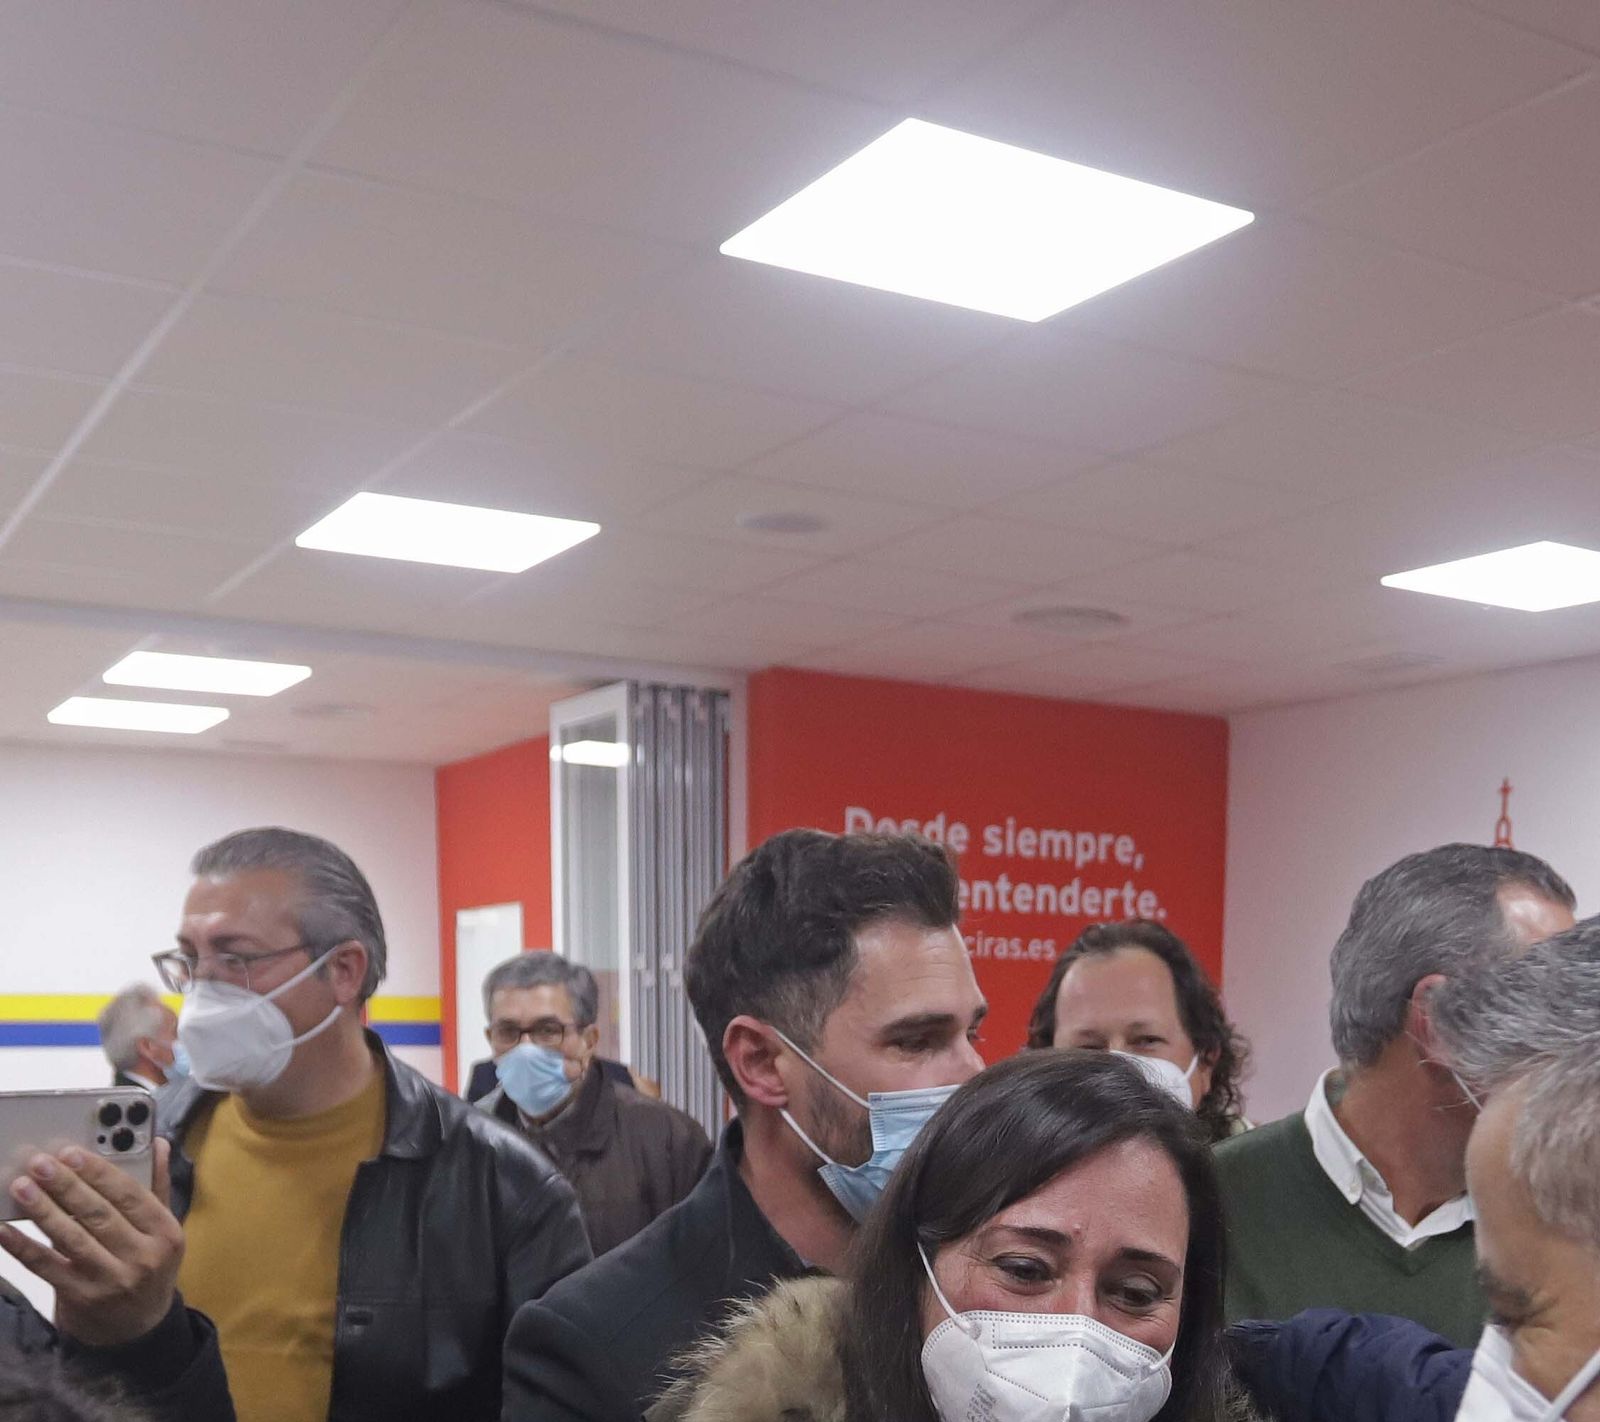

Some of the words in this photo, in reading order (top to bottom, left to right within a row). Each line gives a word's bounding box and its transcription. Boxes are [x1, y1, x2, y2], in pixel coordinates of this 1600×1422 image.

[983, 817, 1144, 869] siempre,
[957, 873, 1167, 920] entenderte.
[963, 930, 1057, 961] ciras.es
